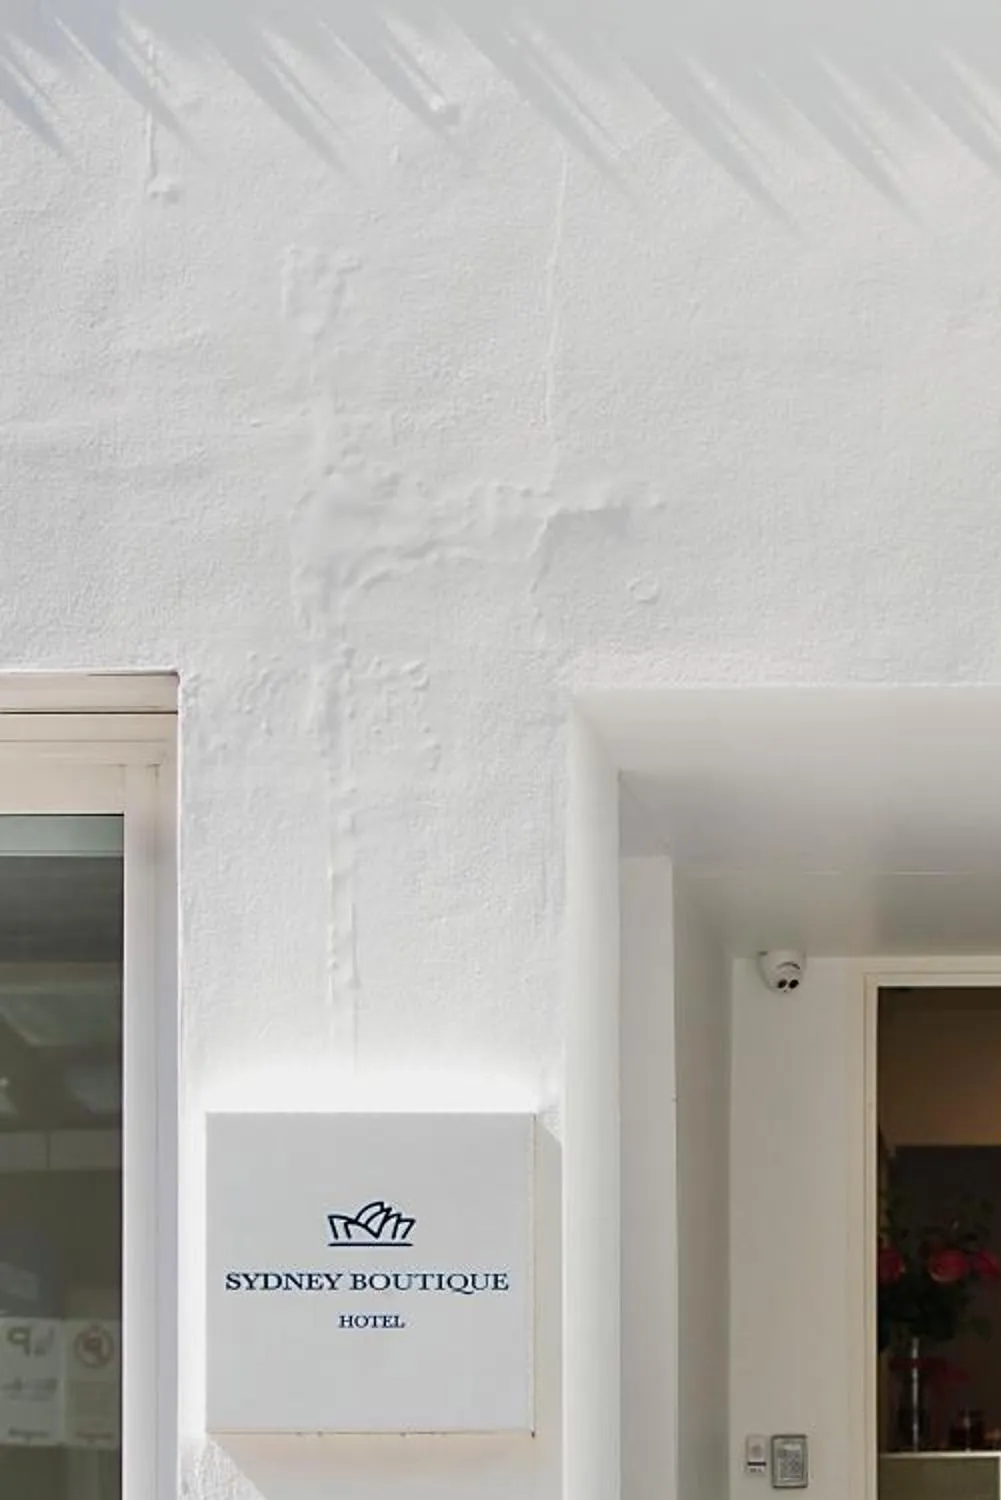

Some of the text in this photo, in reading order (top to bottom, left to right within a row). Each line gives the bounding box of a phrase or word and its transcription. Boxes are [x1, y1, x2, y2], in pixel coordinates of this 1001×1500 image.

[225, 1272, 510, 1295] SYDNEY BOUTIQUE
[338, 1314, 406, 1328] HOTEL
